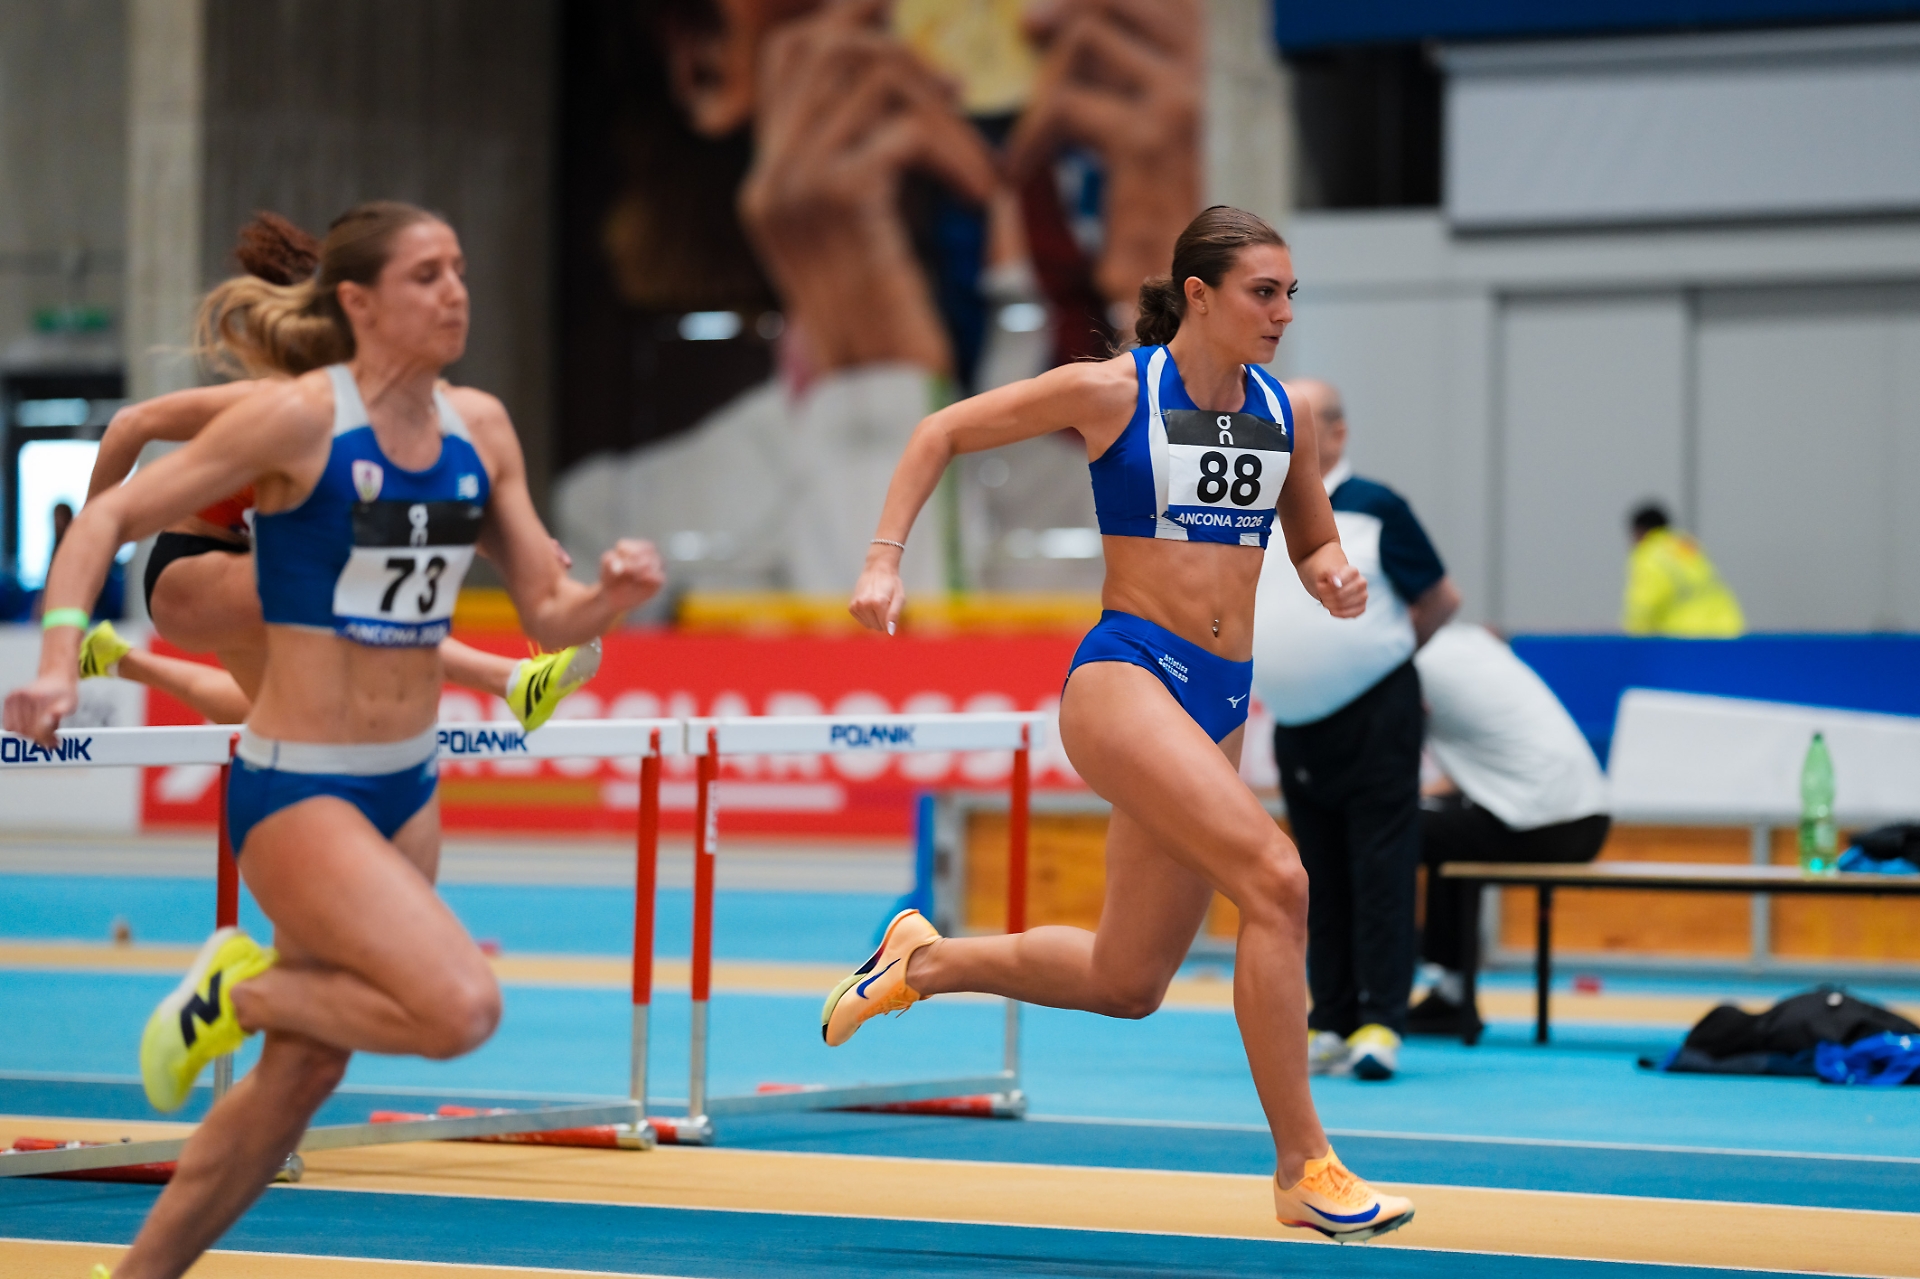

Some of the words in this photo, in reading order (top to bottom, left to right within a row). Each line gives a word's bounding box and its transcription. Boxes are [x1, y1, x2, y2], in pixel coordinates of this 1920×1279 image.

[1197, 451, 1262, 507] 88
[1175, 512, 1233, 528] ANCONA
[1234, 515, 1264, 528] 2026
[380, 556, 446, 614] 73
[437, 730, 529, 754] POLANIK
[830, 723, 916, 747] POLANIK
[0, 736, 93, 763] OLANIK
